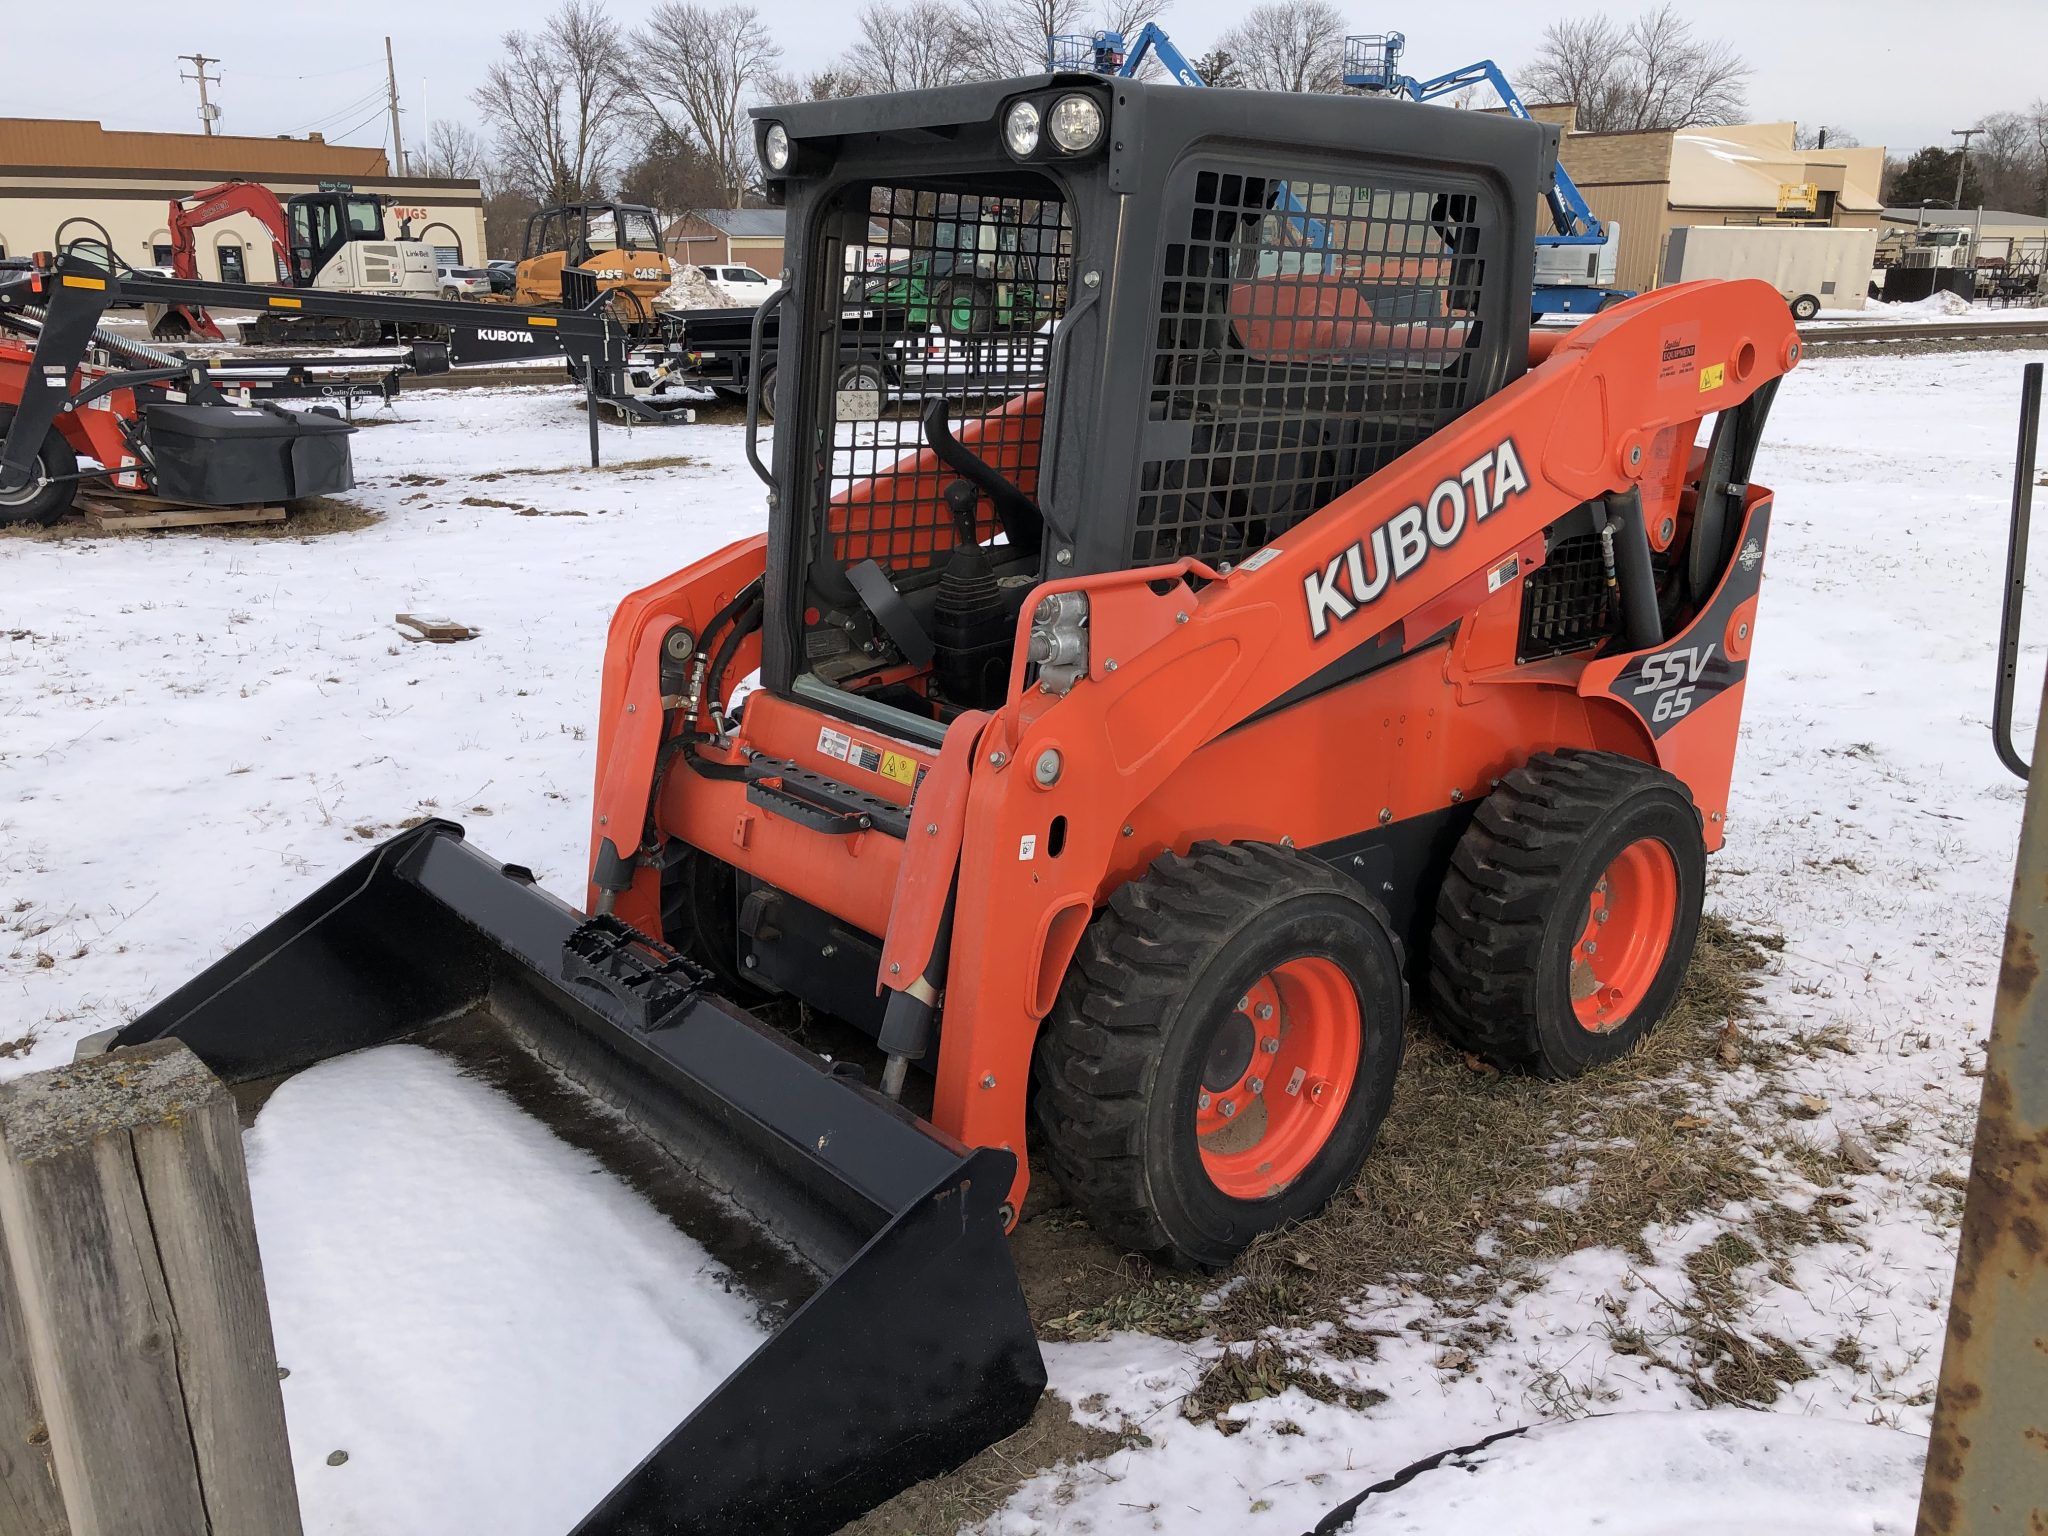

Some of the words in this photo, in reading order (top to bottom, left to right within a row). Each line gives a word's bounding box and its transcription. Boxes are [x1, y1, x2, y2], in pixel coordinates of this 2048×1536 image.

[394, 208, 428, 220] WIGS
[478, 329, 534, 343] KUBOTA
[1663, 346, 1695, 361] EQUIPMENT
[1303, 438, 1529, 639] KUBOTA
[1633, 643, 1717, 696] SSV
[1652, 685, 1696, 723] 65
